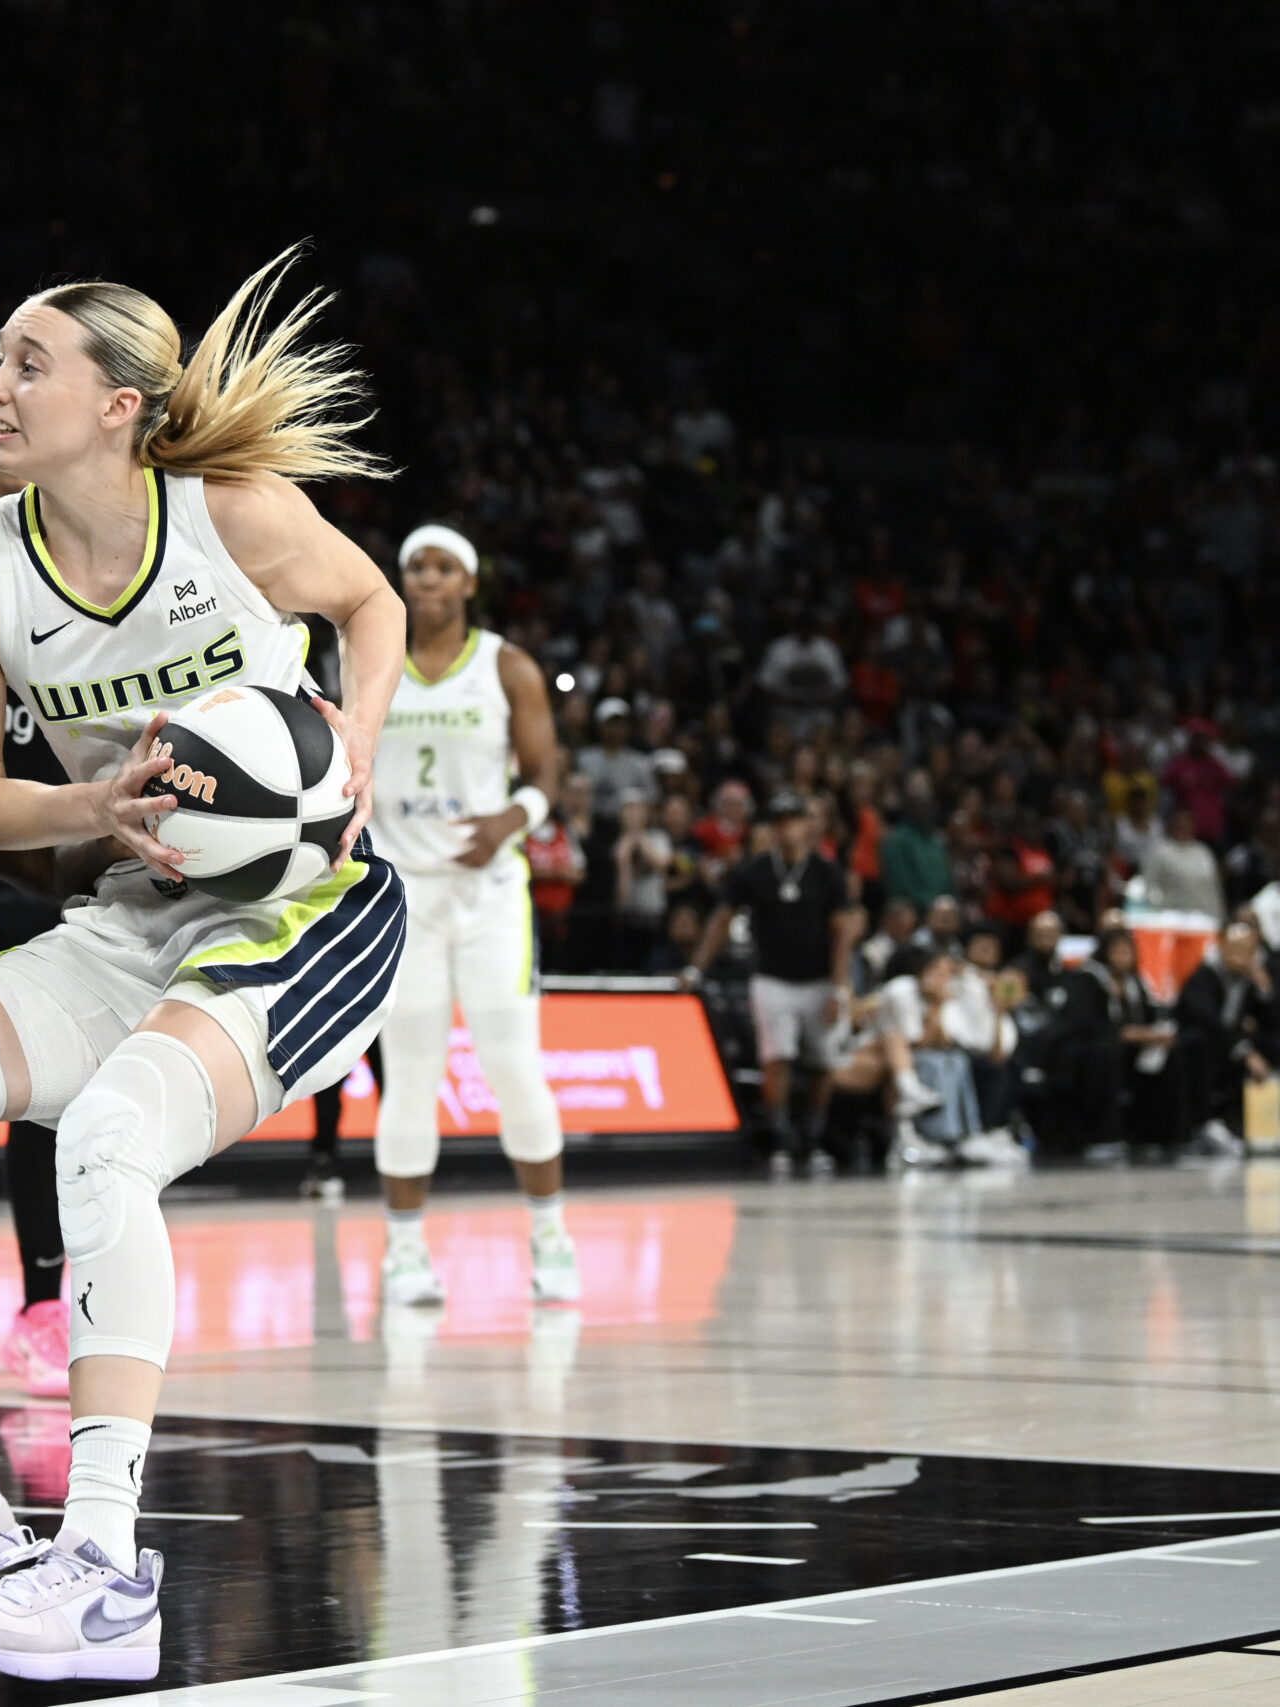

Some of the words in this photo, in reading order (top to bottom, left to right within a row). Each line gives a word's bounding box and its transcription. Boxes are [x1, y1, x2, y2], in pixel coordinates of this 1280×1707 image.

[169, 597, 218, 625] Albert
[26, 624, 246, 725] WINGS
[417, 744, 437, 788] 2
